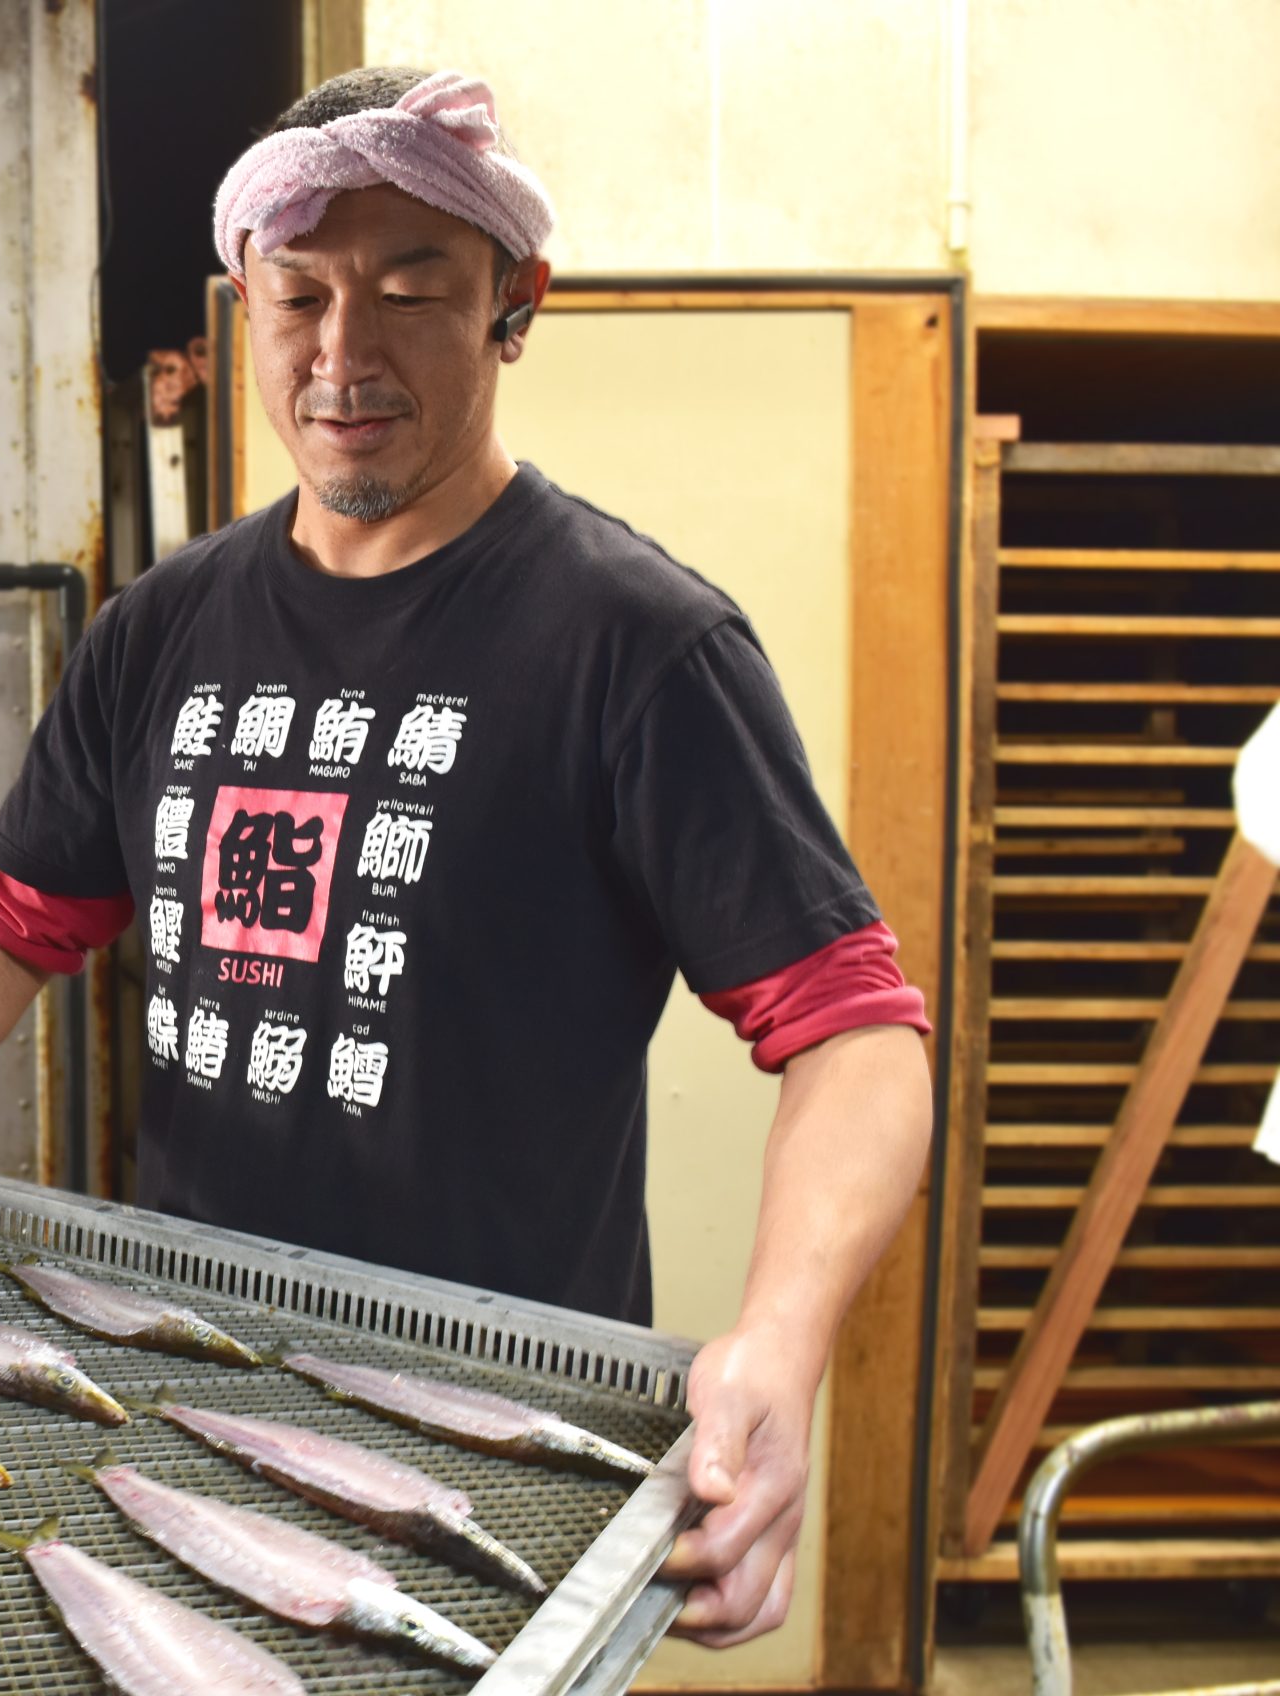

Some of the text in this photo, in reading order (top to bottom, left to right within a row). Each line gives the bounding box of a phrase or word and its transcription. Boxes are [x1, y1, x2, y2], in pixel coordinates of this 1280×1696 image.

[193, 682, 221, 693] salmon
[256, 683, 287, 693] bream
[340, 688, 365, 699] tuna
[416, 692, 468, 707] mackerel
[170, 694, 224, 756] 鮭
[230, 694, 296, 758] 鯛
[309, 698, 376, 764] 鮪
[387, 704, 467, 774] 鯖
[173, 759, 195, 771] SAKE
[243, 760, 257, 771] TAI
[309, 764, 350, 778] MAGURO
[398, 772, 426, 786] SABA
[166, 785, 191, 796] conger
[377, 799, 434, 816] yellowtail
[154, 794, 195, 859] 鱧
[357, 811, 433, 884] 鰤
[215, 809, 324, 933] 鮨
[372, 882, 397, 898] BURI
[362, 910, 400, 926] flatfish
[149, 895, 184, 963] 鰹
[344, 922, 407, 996] 鮃
[217, 957, 284, 988] SUSHI
[200, 996, 220, 1011] sierra
[348, 995, 387, 1013] HIRAME
[264, 1009, 299, 1023] sardine
[352, 1024, 369, 1035] cod
[185, 1005, 230, 1079] 鰆
[247, 1020, 308, 1094] 鰯
[326, 1033, 388, 1107] 鱈
[186, 1072, 212, 1091] SAWARA
[251, 1089, 280, 1104] IWASHI
[342, 1102, 362, 1117] TARA
